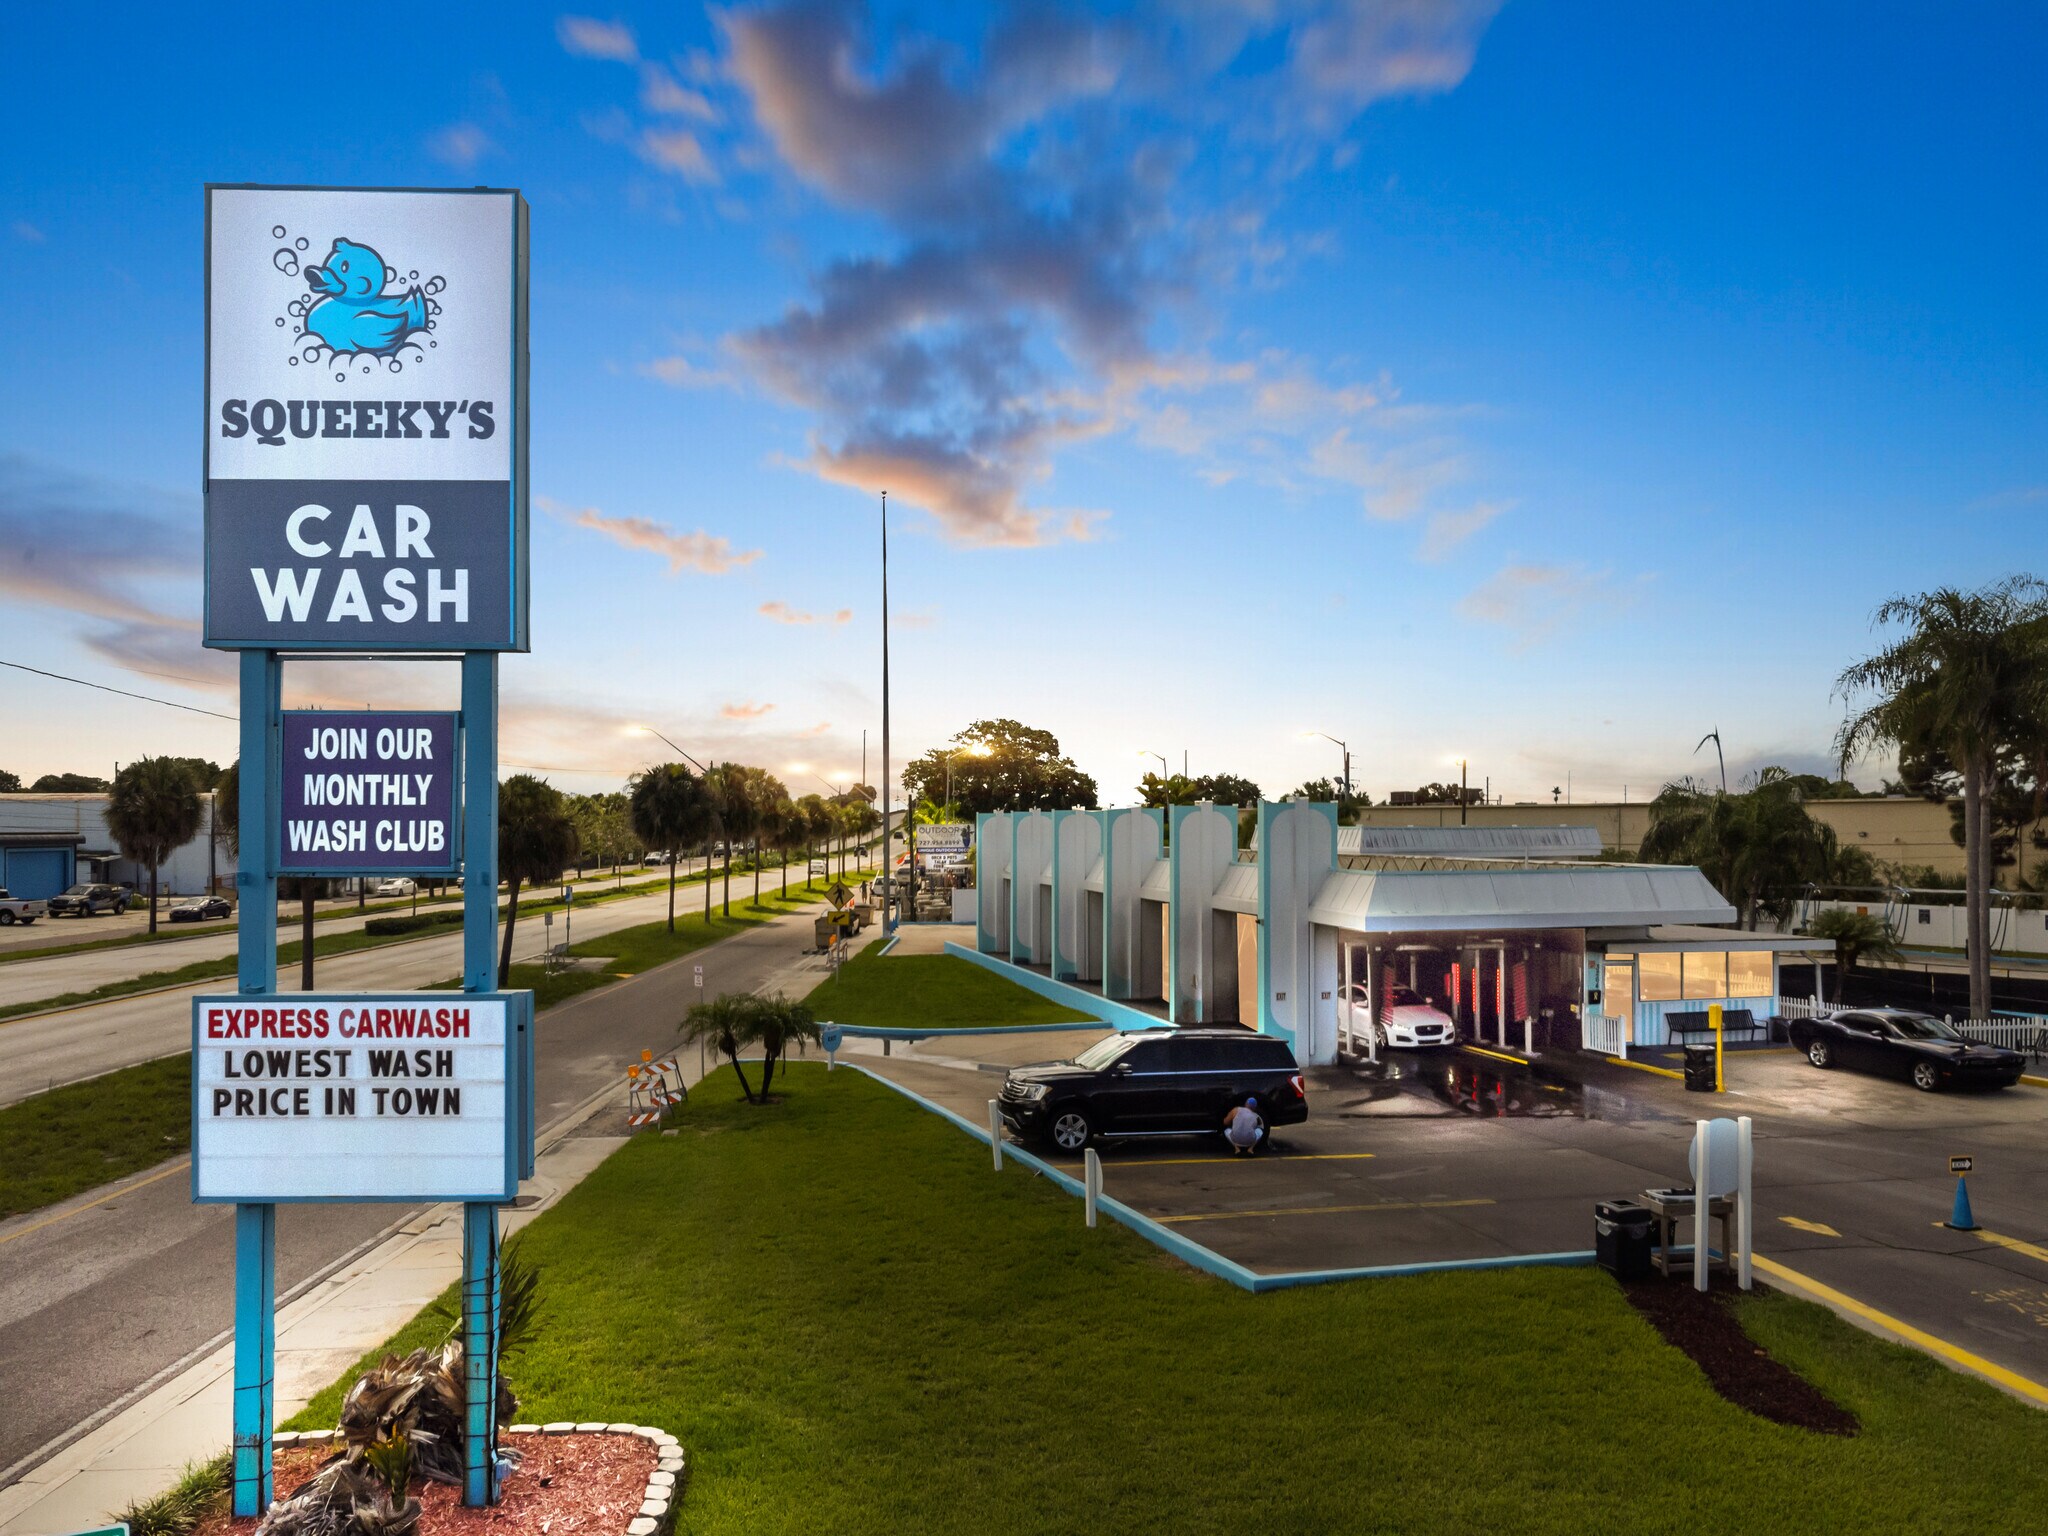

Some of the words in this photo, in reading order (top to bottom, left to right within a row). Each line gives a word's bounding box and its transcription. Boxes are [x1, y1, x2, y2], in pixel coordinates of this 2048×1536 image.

[221, 398, 496, 446] SQUEEKY'S
[285, 504, 435, 558] CAR
[250, 567, 469, 623] WASH
[304, 728, 367, 760] JOIN
[376, 728, 433, 760] OUR
[304, 774, 433, 806] MONTHLY
[288, 820, 367, 852] WASH
[375, 820, 445, 852] CLUB
[208, 1009, 329, 1038] EXPRESS
[342, 1009, 470, 1038] CARWASH
[225, 1049, 352, 1078] LOWEST
[368, 1049, 453, 1078] WASH
[213, 1088, 310, 1116] PRICE
[324, 1088, 356, 1116] IN
[372, 1088, 461, 1116] TOWN
